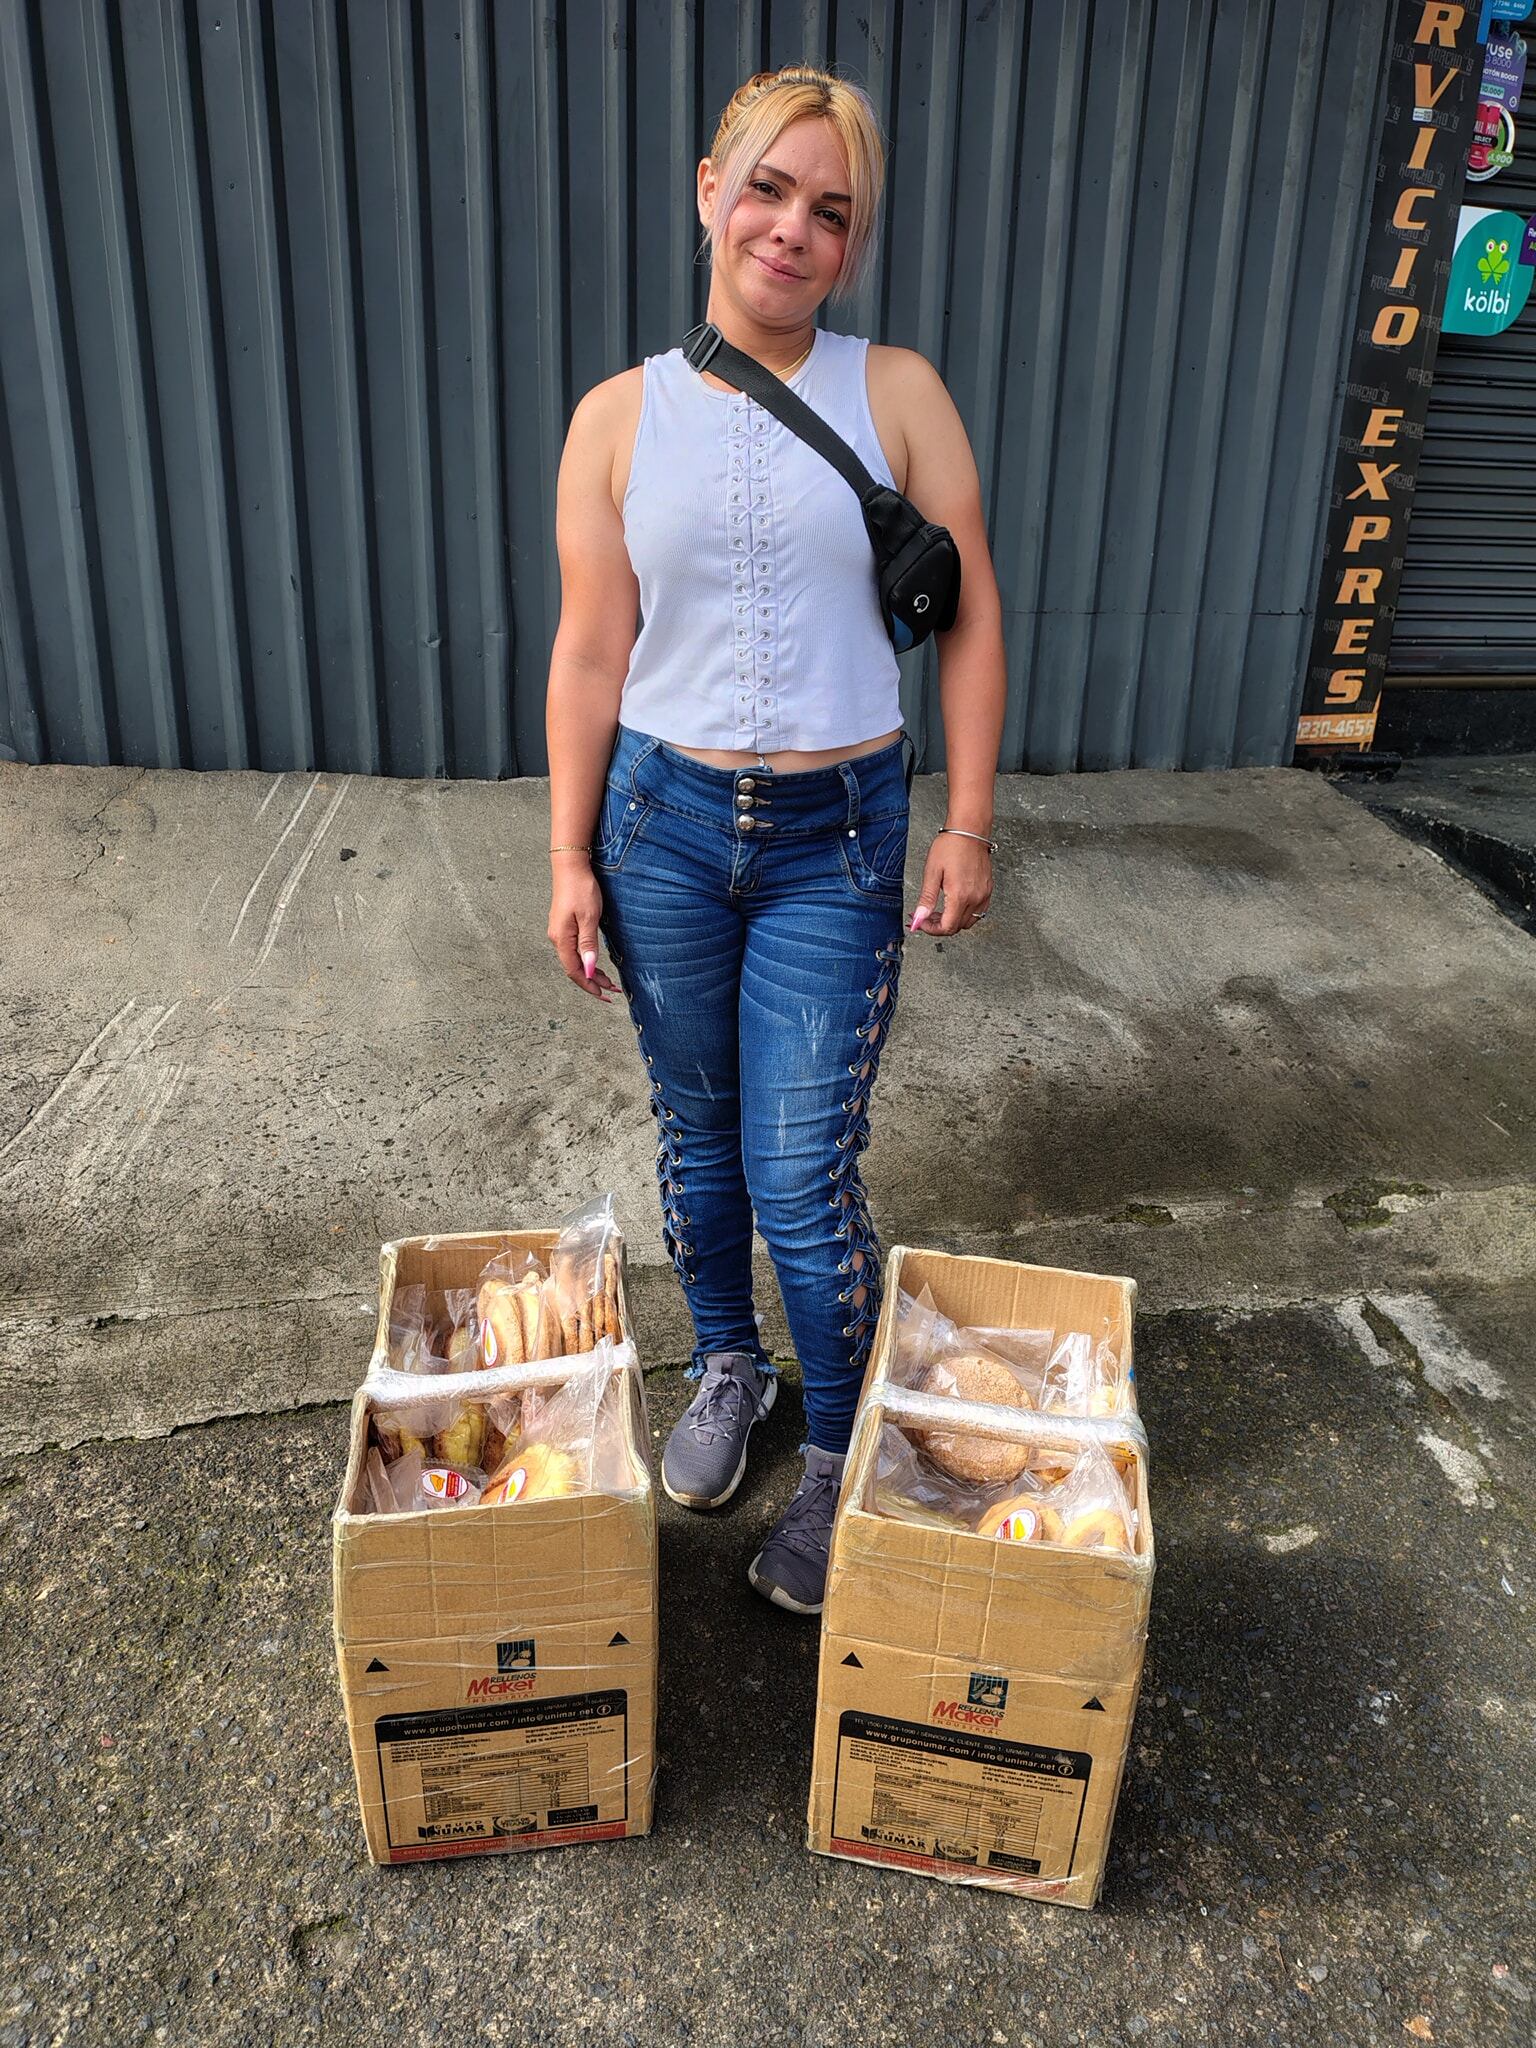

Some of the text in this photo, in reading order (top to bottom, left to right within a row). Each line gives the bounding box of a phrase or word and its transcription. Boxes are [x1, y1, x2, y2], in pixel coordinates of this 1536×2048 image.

[1464, 287, 1510, 315] kölbi
[1325, 408, 1403, 705] EXPRES
[467, 1677, 535, 1697] Maker
[491, 1673, 536, 1683] RELLENOS
[933, 1701, 1002, 1727] Maker
[958, 1704, 1005, 1718] RELLENOS
[404, 1719, 509, 1735] www.gruponumar.com
[518, 1708, 593, 1723] info@unimar.net
[932, 1719, 1001, 1735] INDUSTRIAL
[866, 1730, 969, 1755] www.gruponumar.com
[977, 1750, 1056, 1771] info@unimar.net
[434, 1824, 484, 1835] NUMAR
[435, 1820, 481, 1828] GRUPO
[876, 1834, 926, 1850] NUMAR
